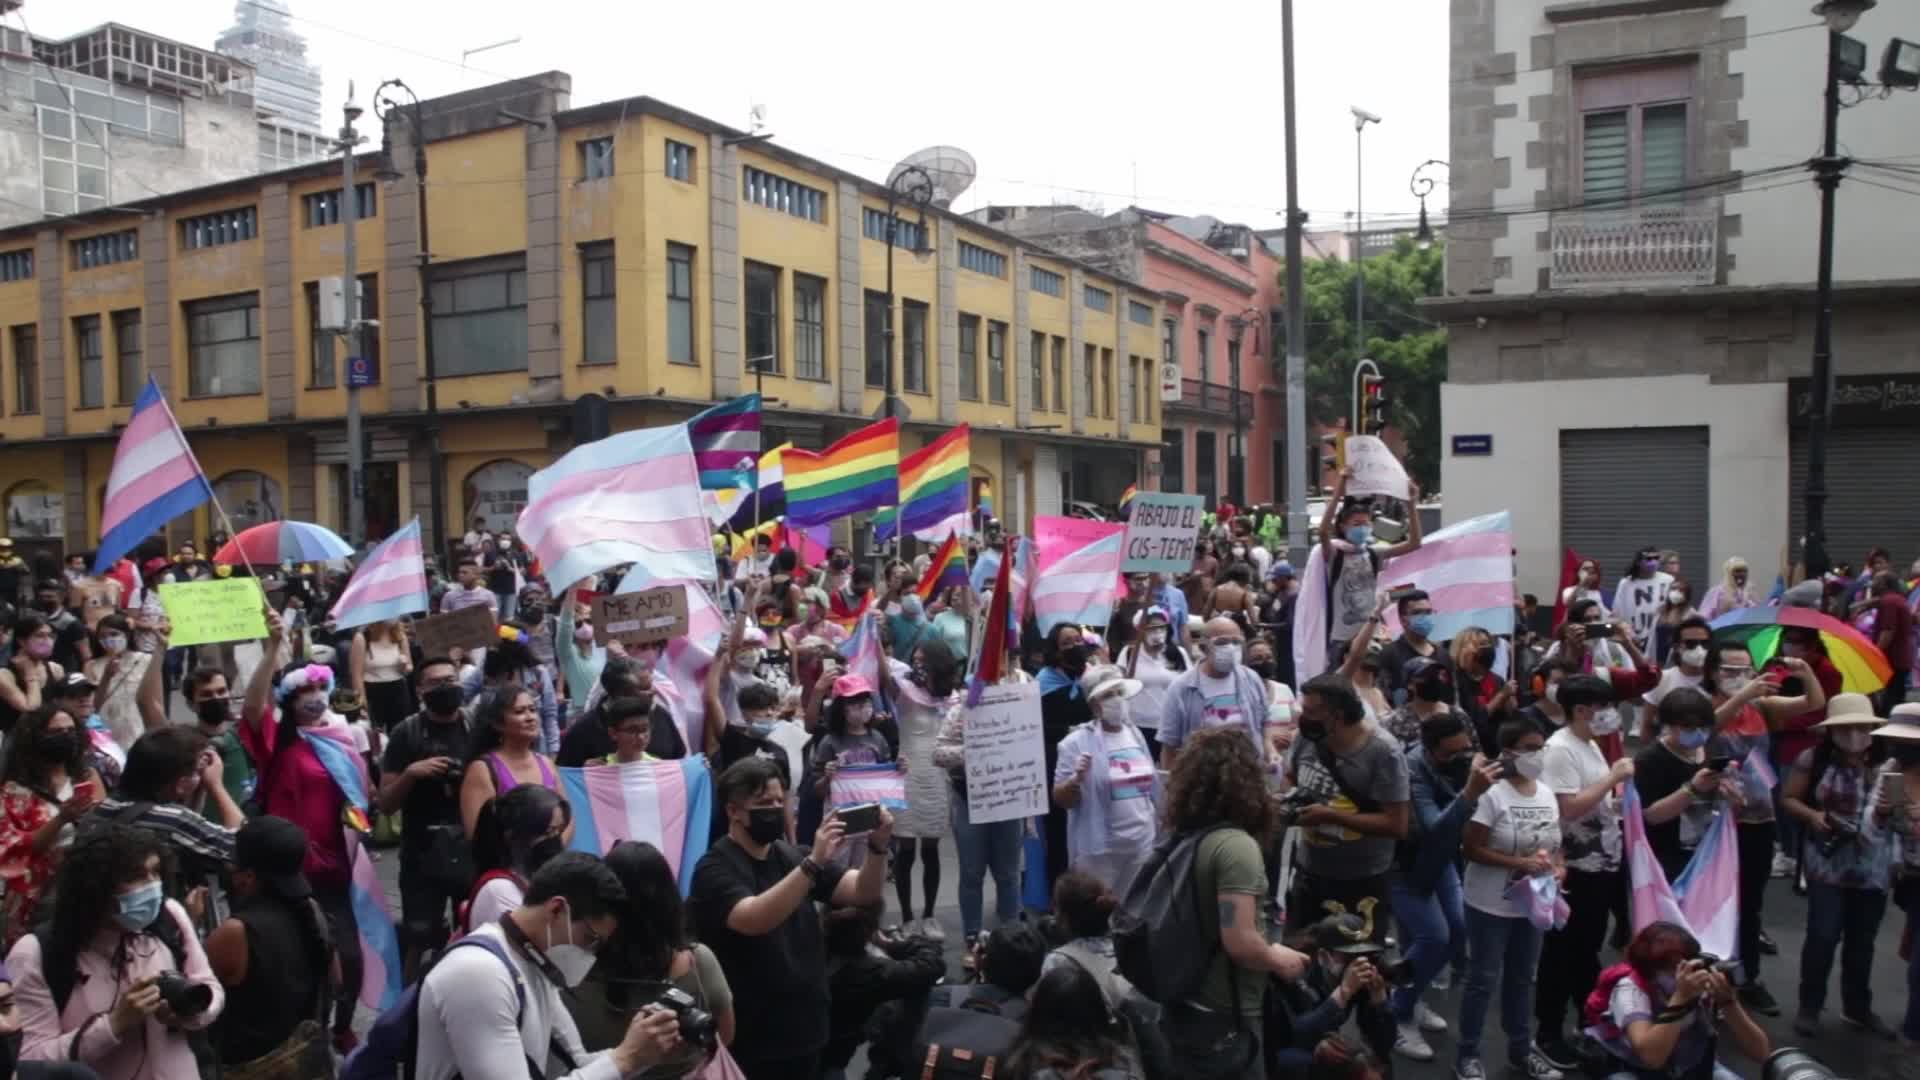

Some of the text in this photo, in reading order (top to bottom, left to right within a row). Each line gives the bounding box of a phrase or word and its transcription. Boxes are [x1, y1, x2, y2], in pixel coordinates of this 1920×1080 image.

[1136, 502, 1195, 529] ABAJO EL
[1128, 537, 1193, 561] CIS-TEMA
[603, 592, 673, 616] ME AMO
